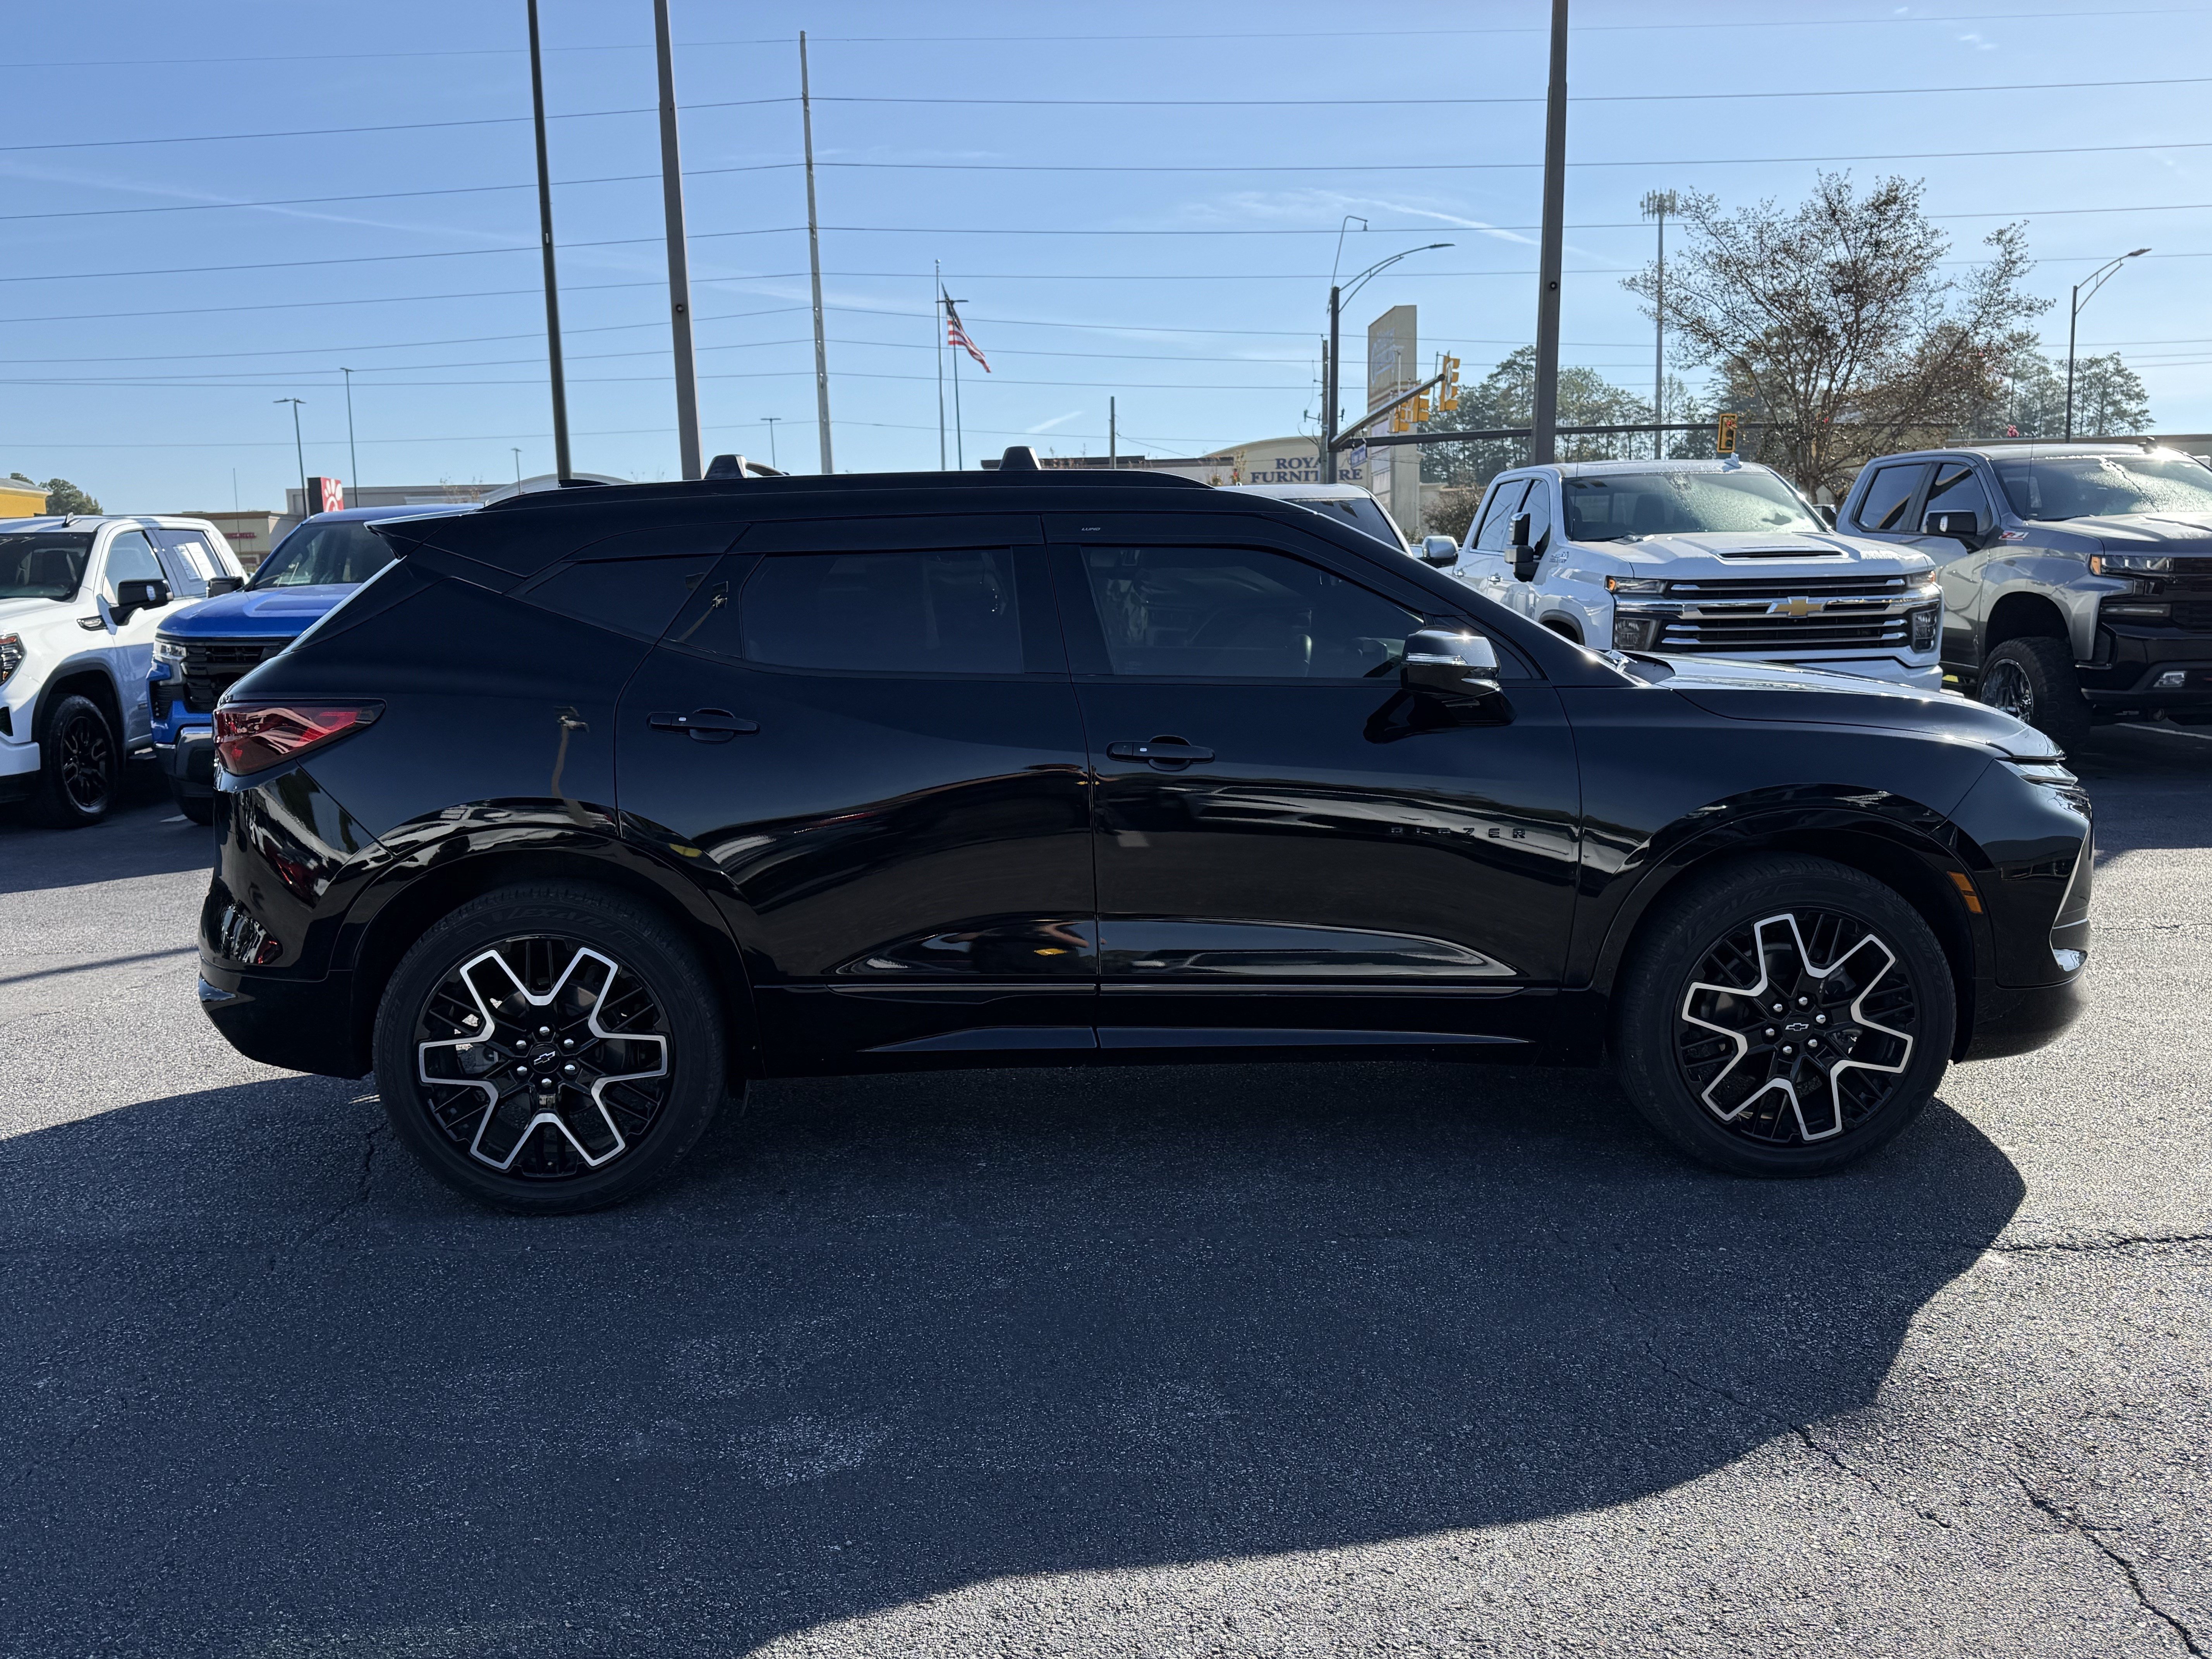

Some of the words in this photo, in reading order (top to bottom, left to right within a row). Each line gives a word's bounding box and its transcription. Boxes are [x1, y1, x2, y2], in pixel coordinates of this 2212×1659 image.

[1275, 457, 1321, 469] ROYA
[1250, 469, 1362, 483] FURNITRE
[1390, 827, 1526, 839] BLAZER
